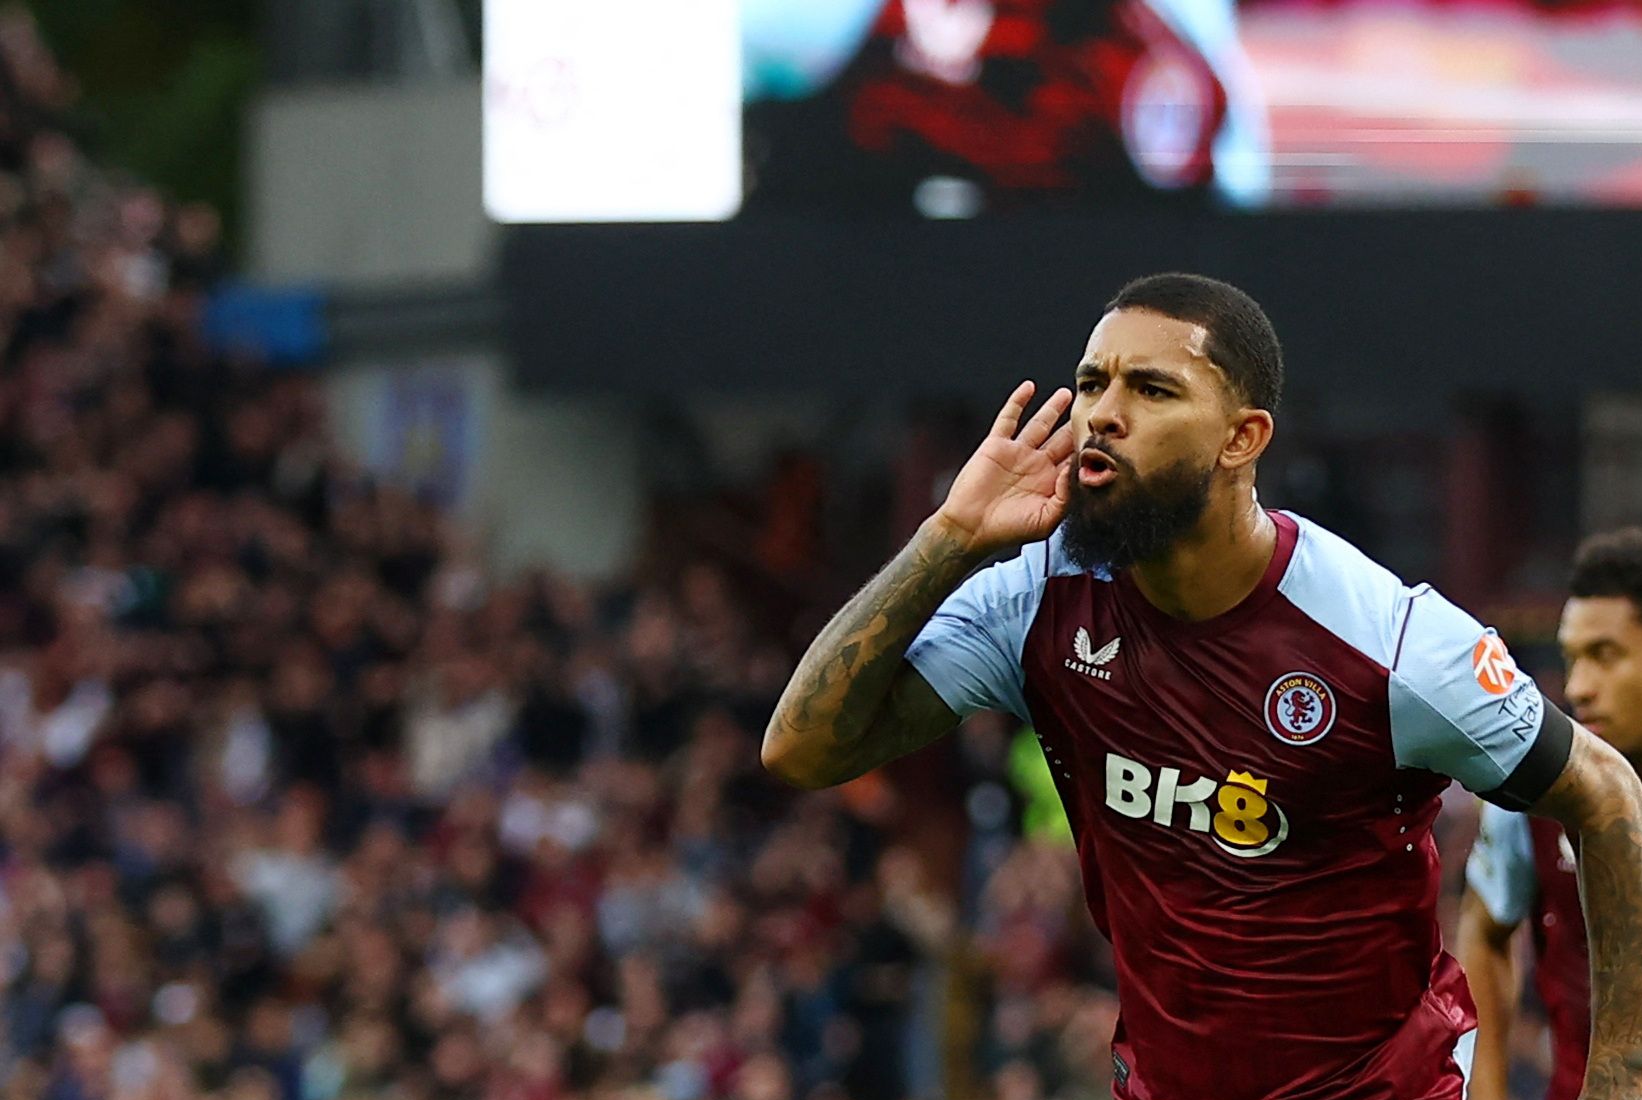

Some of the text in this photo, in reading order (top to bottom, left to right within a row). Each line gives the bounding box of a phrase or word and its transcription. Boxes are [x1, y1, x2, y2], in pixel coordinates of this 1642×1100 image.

[1063, 658, 1112, 680] CASTORE
[1275, 679, 1326, 700] ASTON VILLA
[1105, 752, 1270, 846] BK8
